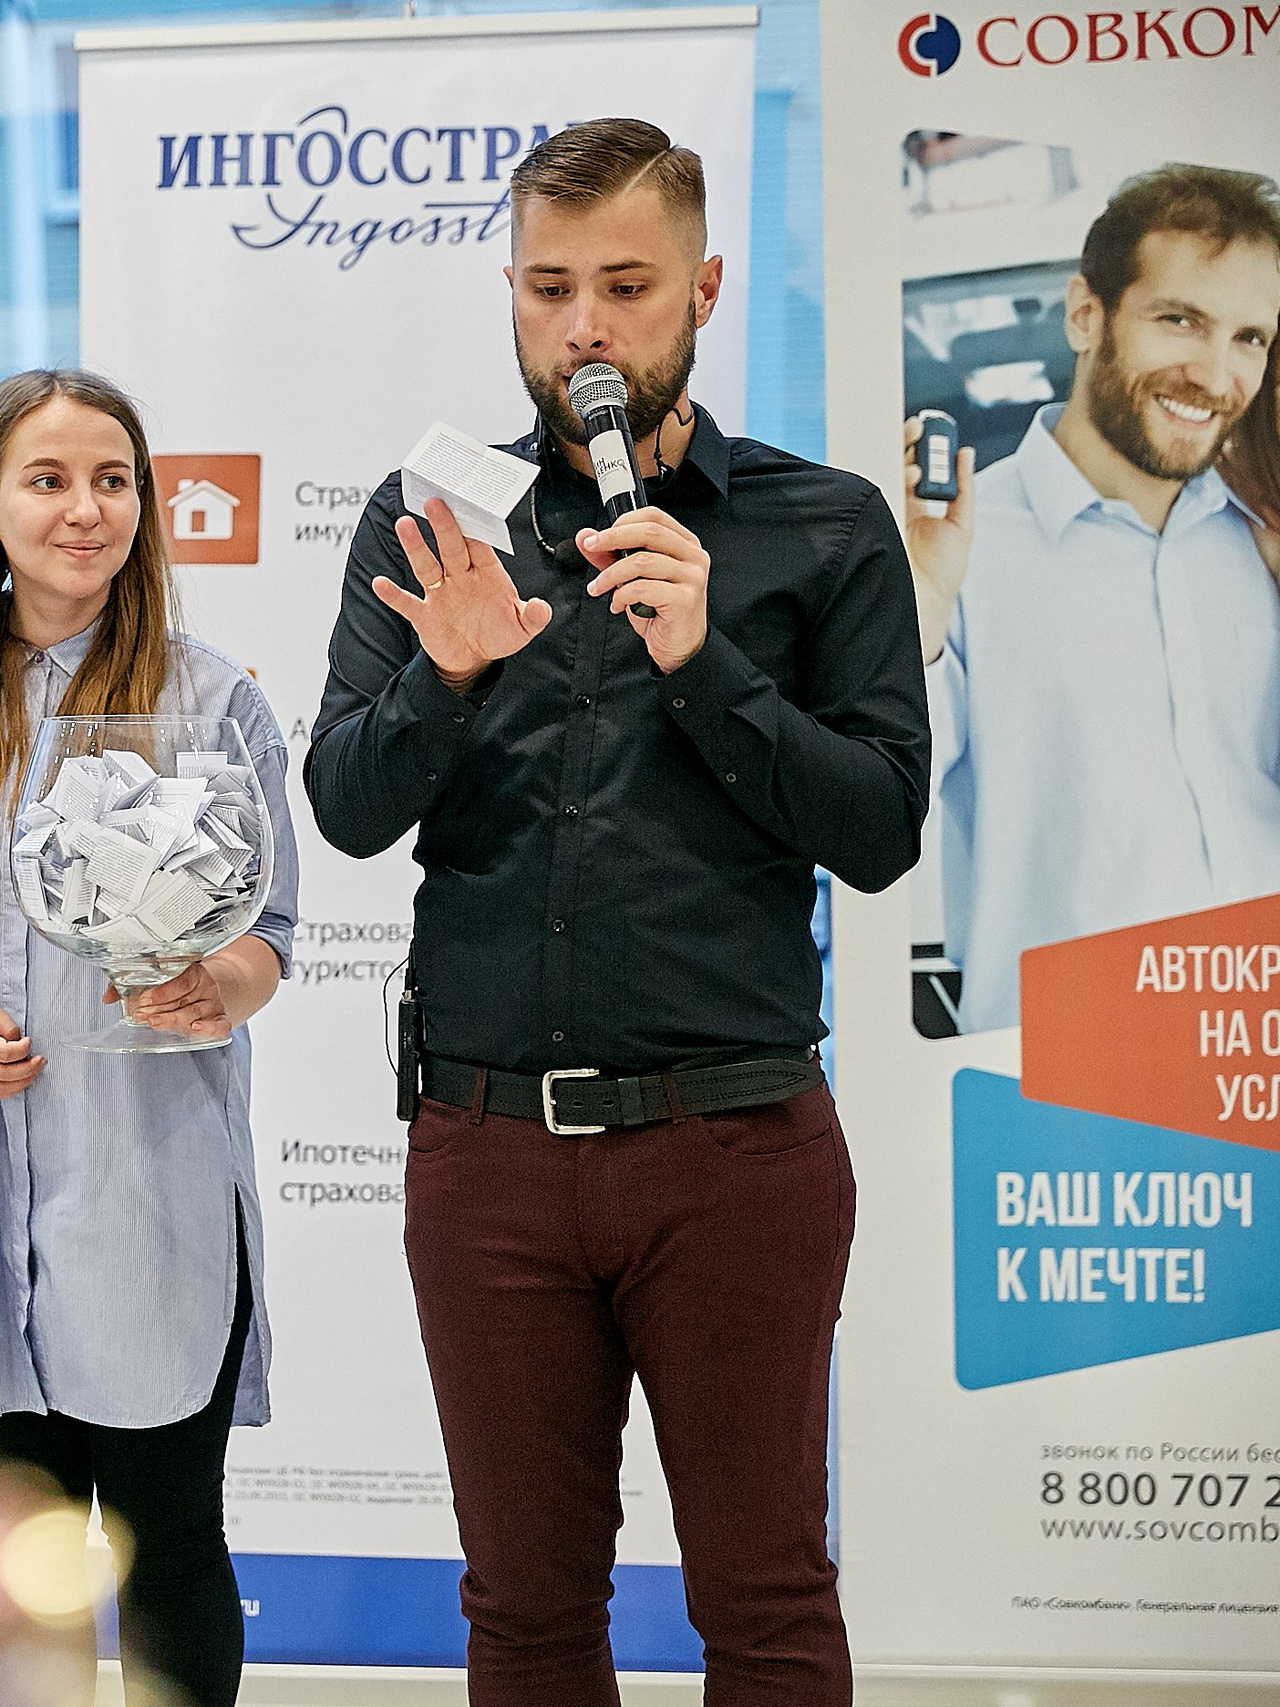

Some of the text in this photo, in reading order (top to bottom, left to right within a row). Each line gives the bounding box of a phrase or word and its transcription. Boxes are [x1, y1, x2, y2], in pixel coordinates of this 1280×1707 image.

[976, 5, 1280, 68] СОВКОМ
[157, 104, 582, 189] ИНГОССТР
[1136, 944, 1280, 994] АВТОКР
[1200, 1009, 1252, 1058] НА
[996, 1171, 1253, 1228] ВАШ КЛЮЧ
[996, 1247, 1207, 1304] К МЕЧТЕ!
[1040, 1444, 1121, 1461] звонок
[1125, 1445, 1154, 1461] по
[1160, 1441, 1240, 1463] России
[1040, 1472, 1065, 1505] 8
[1079, 1472, 1157, 1506] 800
[1171, 1474, 1250, 1507] 707
[1040, 1515, 1280, 1543] www.sovcomb
